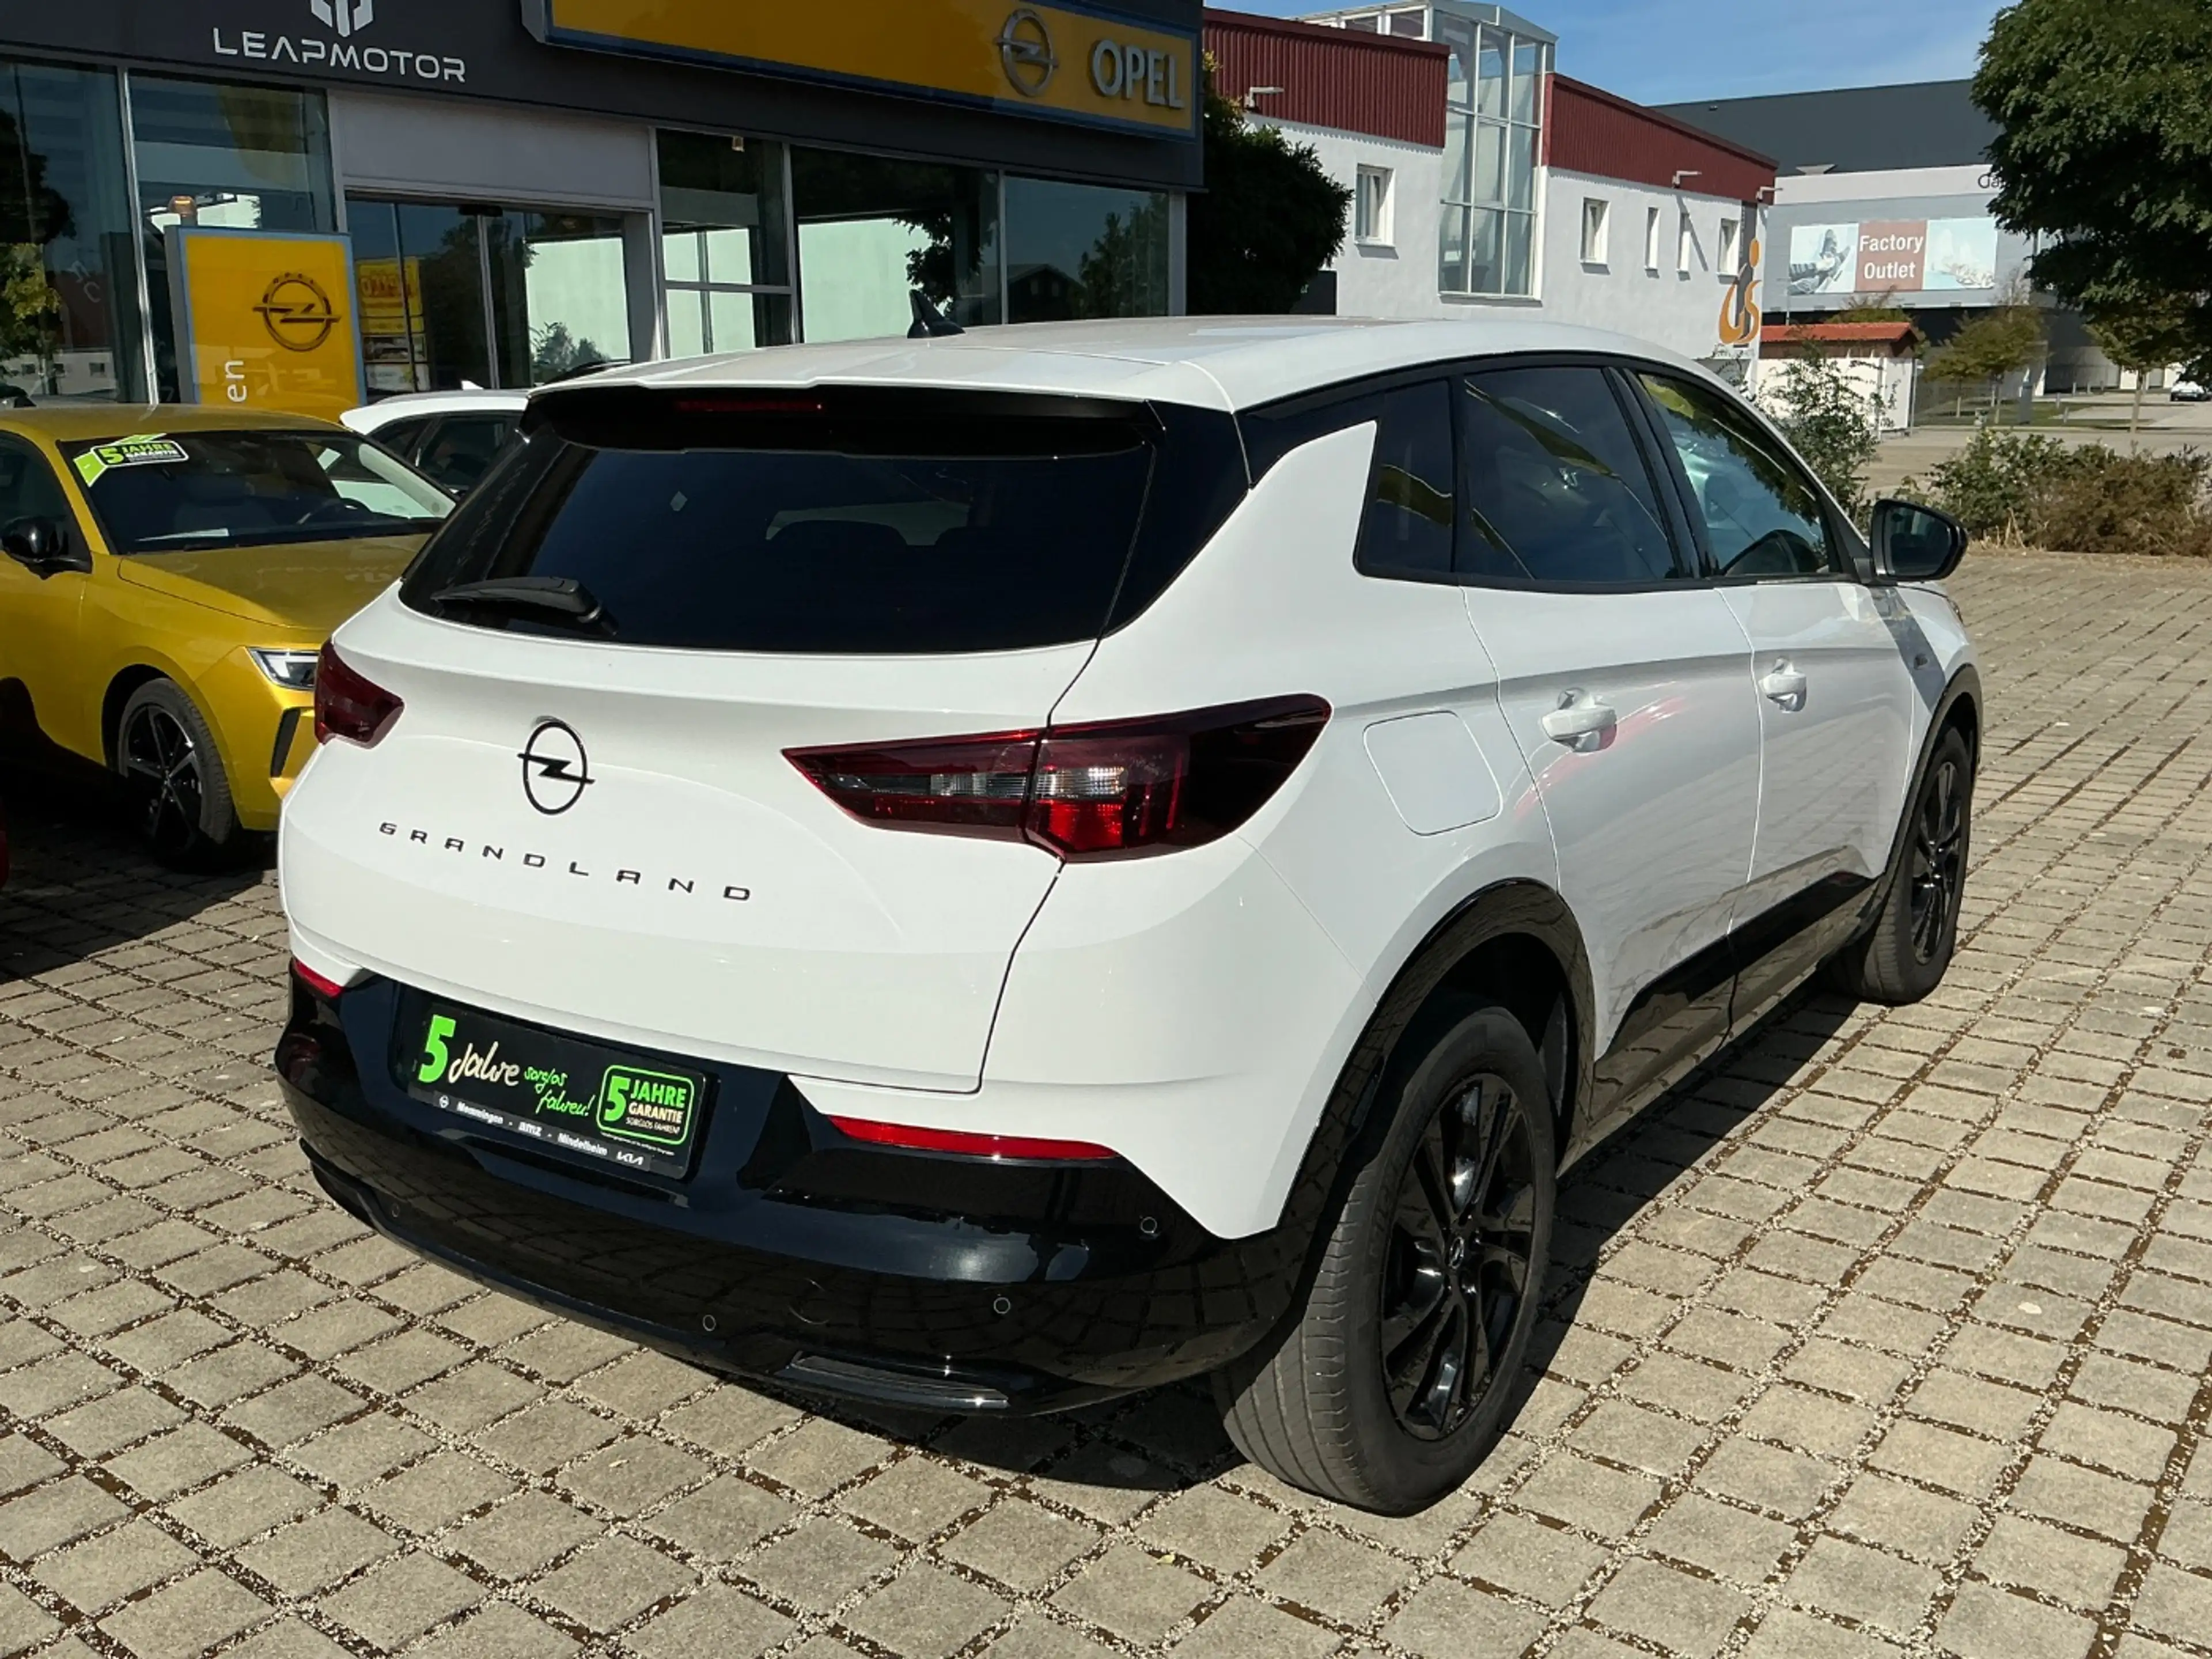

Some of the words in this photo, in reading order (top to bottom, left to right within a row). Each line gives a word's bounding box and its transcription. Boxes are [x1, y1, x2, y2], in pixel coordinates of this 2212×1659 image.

[213, 27, 465, 82] LEAPMOTOR
[1091, 39, 1185, 108] OPEL
[1859, 234, 1923, 253] Factory
[1864, 262, 1915, 279] Outlet
[99, 447, 124, 463] 5
[379, 822, 750, 901] GRANDLAND
[418, 1014, 456, 1082] 5
[604, 1075, 631, 1121] 5
[630, 1079, 687, 1108] JAHRE
[628, 1101, 684, 1124] GARANTIE
[457, 1101, 503, 1124] Memmingen
[558, 1132, 608, 1156] Mindelheim
